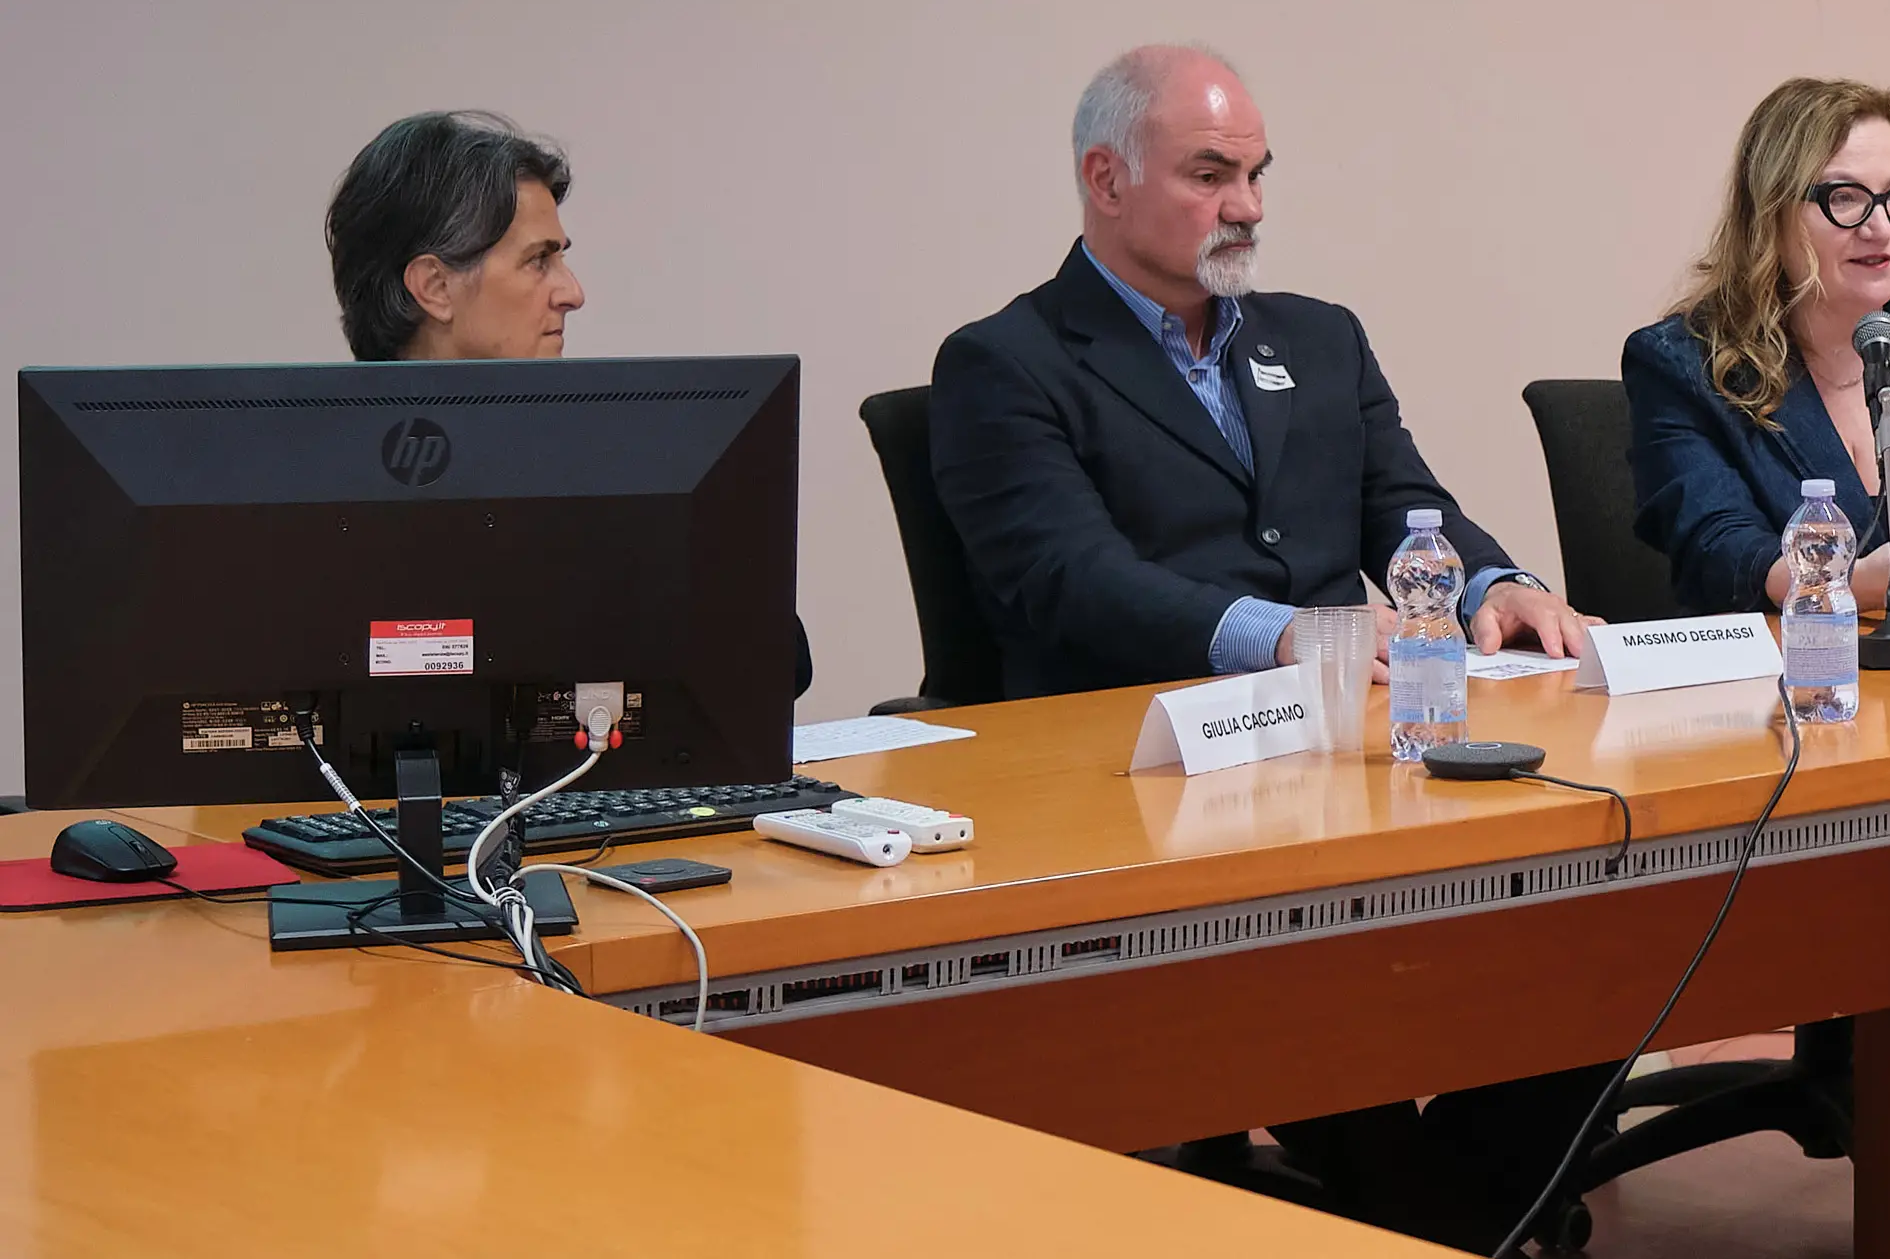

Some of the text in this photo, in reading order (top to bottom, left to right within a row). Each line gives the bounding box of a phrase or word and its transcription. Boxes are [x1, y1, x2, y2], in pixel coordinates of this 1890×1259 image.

[390, 418, 447, 490] hp
[1622, 626, 1755, 647] MASSIMO DEGRASSI
[424, 661, 464, 671] 0092936
[1202, 703, 1305, 740] GIULIA CACCAMO
